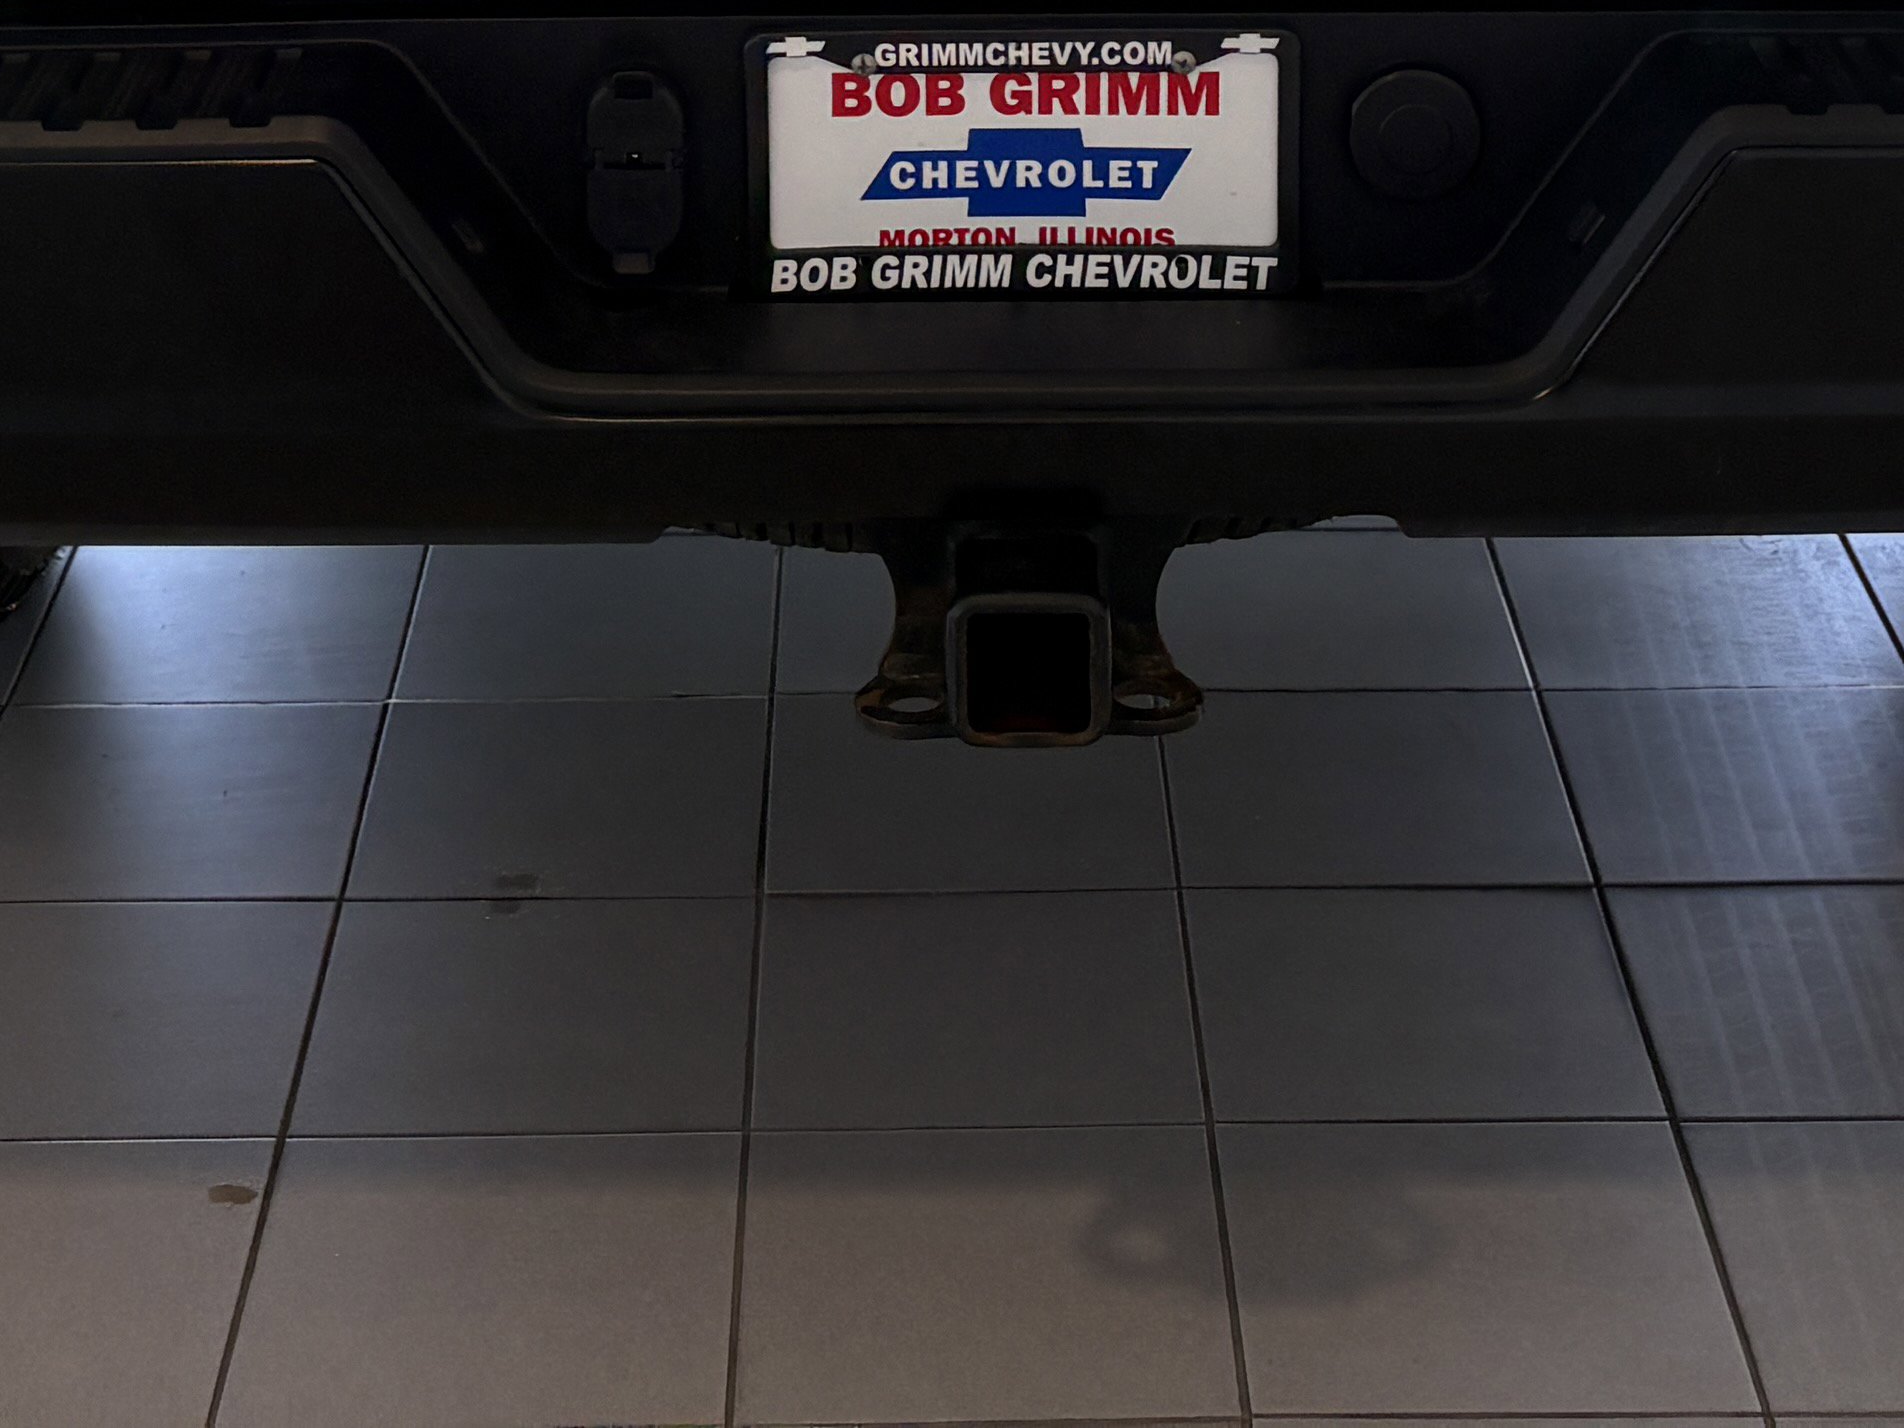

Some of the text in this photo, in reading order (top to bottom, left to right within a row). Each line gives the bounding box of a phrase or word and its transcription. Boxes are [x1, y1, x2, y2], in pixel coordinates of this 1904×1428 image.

[873, 41, 1173, 68] GRIMMCHEVY.COM
[831, 71, 1220, 117] BOB GRIMM
[889, 159, 1160, 190] CHEVROLET
[1038, 225, 1176, 247] ILLINOIS
[771, 253, 1278, 293] BOB GRIMM CHEVROLET
